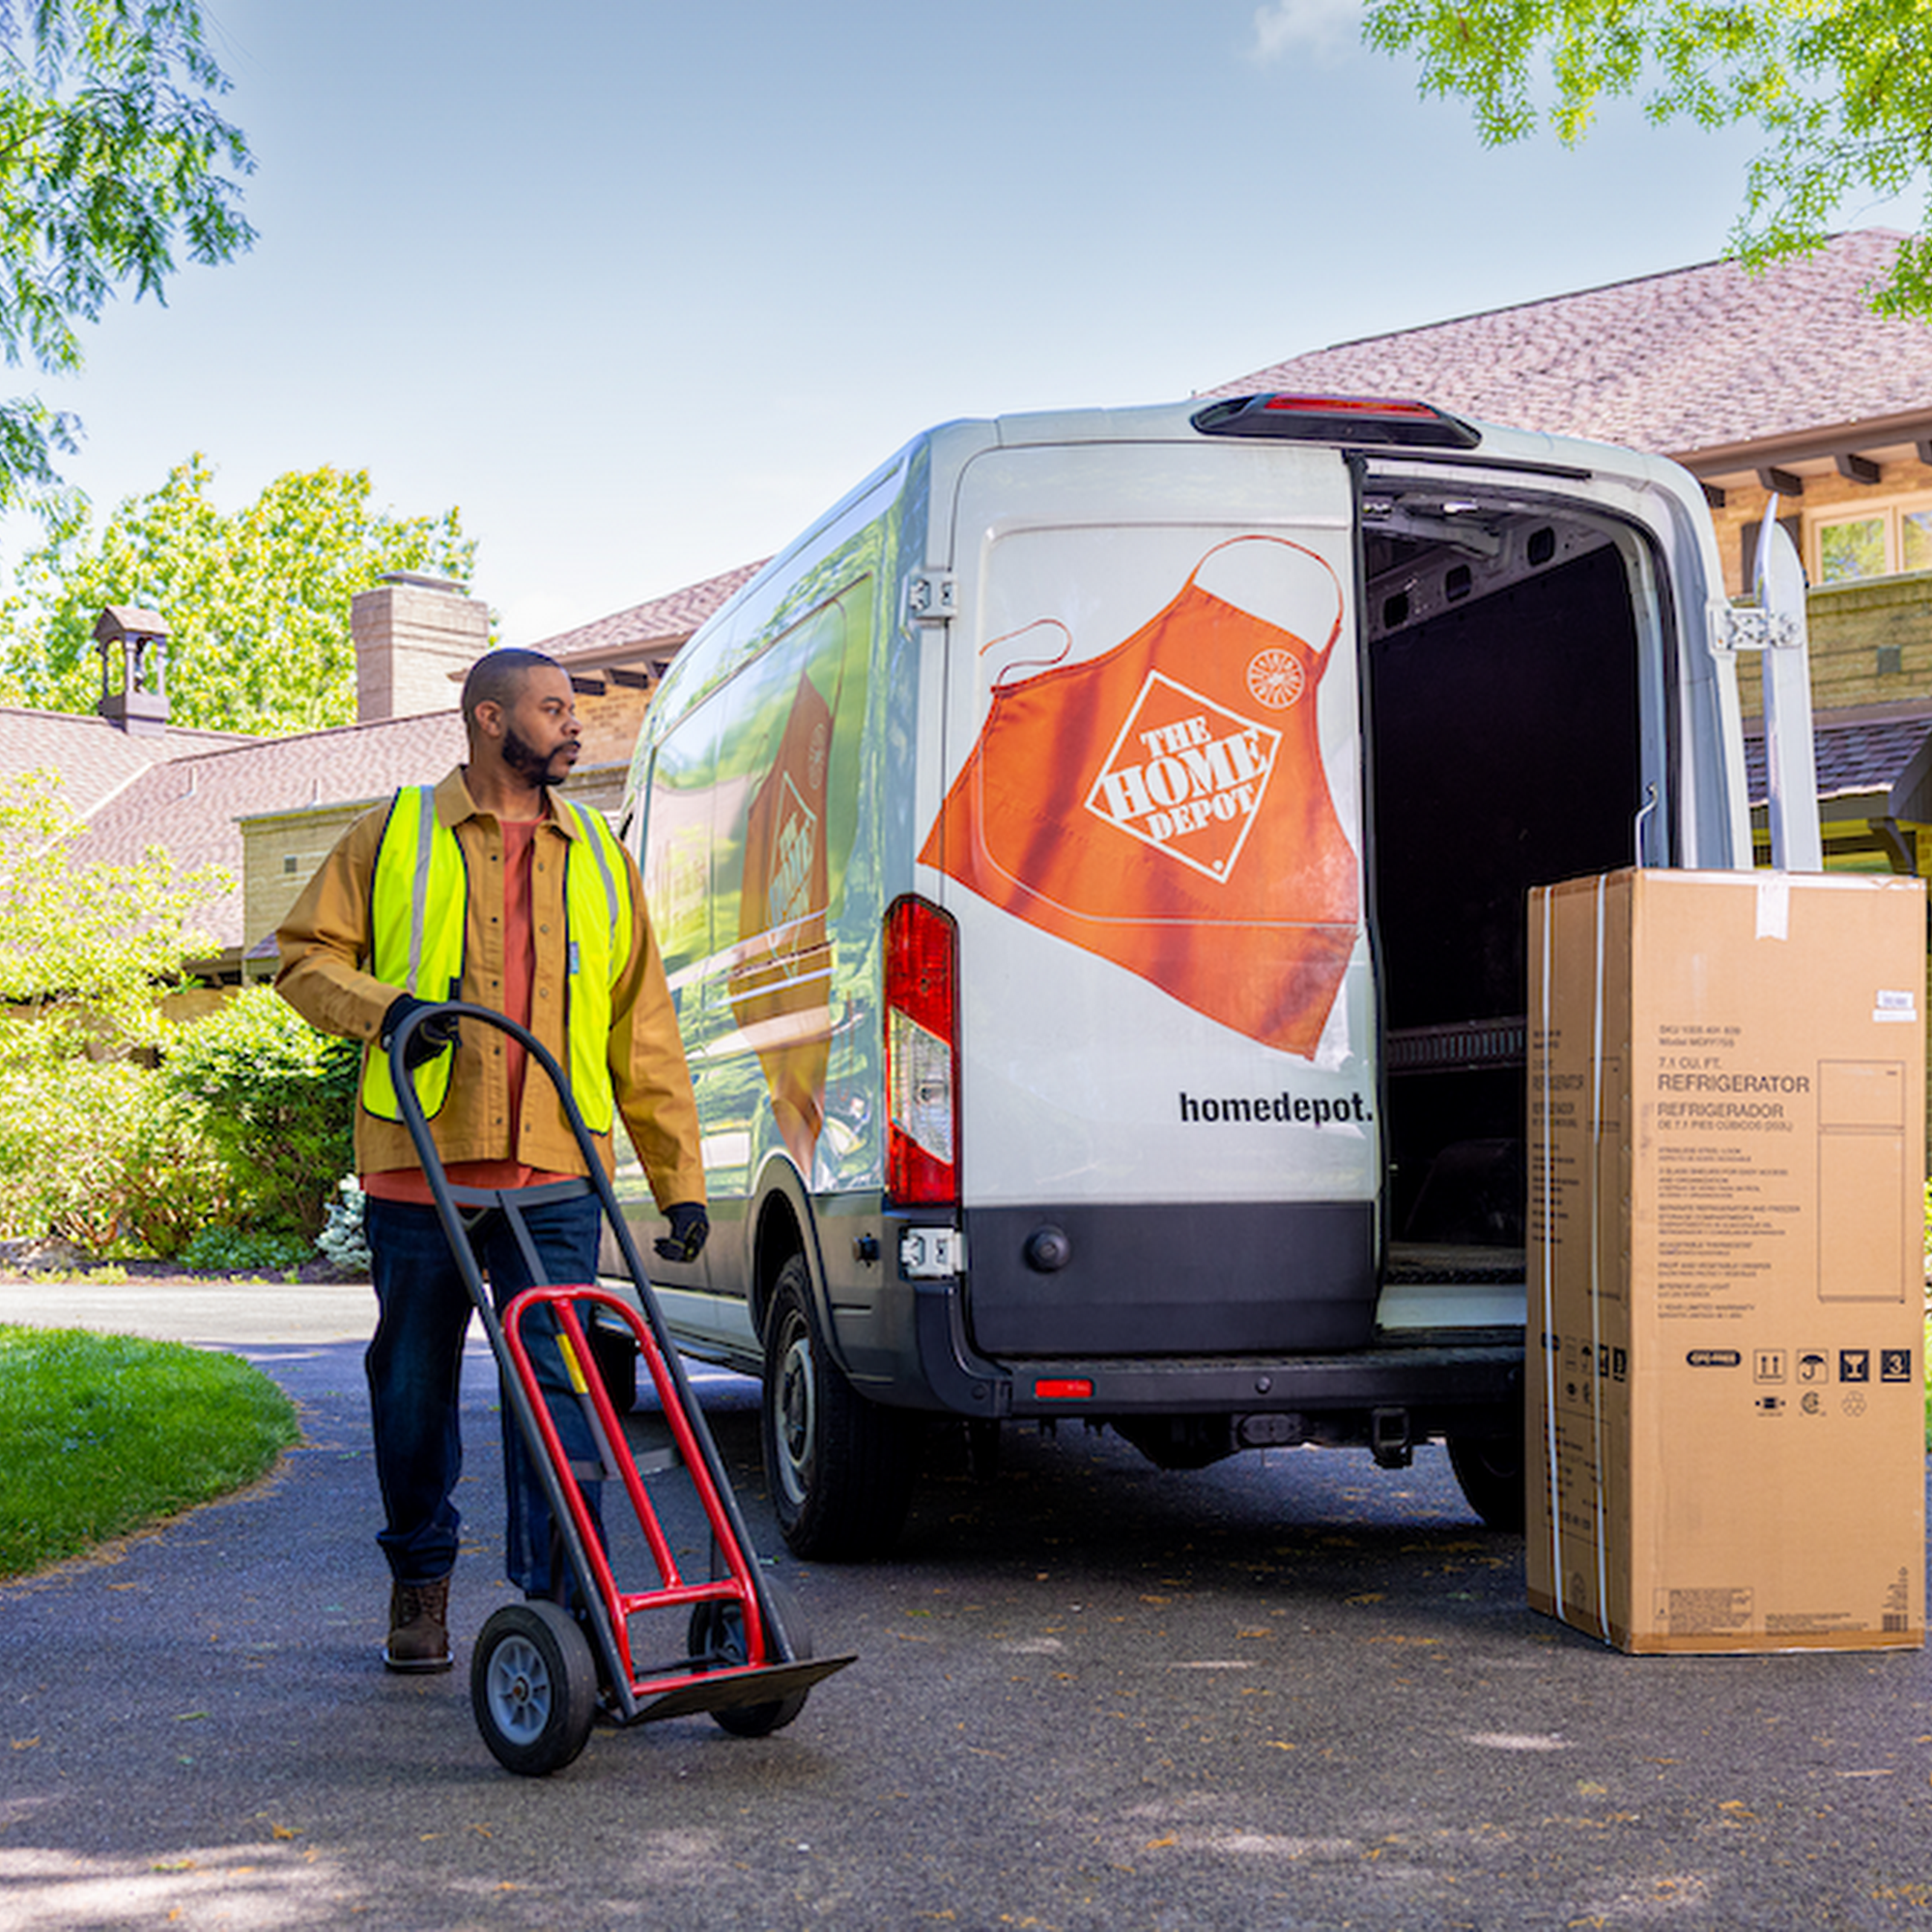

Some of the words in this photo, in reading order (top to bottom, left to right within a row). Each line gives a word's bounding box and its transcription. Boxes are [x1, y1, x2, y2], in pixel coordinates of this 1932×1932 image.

[1140, 716, 1211, 757] THE
[1102, 727, 1266, 821] HOME
[1147, 783, 1254, 841] DEPOT
[1658, 1073, 1810, 1094] REFRIGERATOR
[1179, 1092, 1373, 1128] homedepot.
[1657, 1102, 1784, 1119] REFRIGERADOR
[1889, 1354, 1903, 1374] 3
